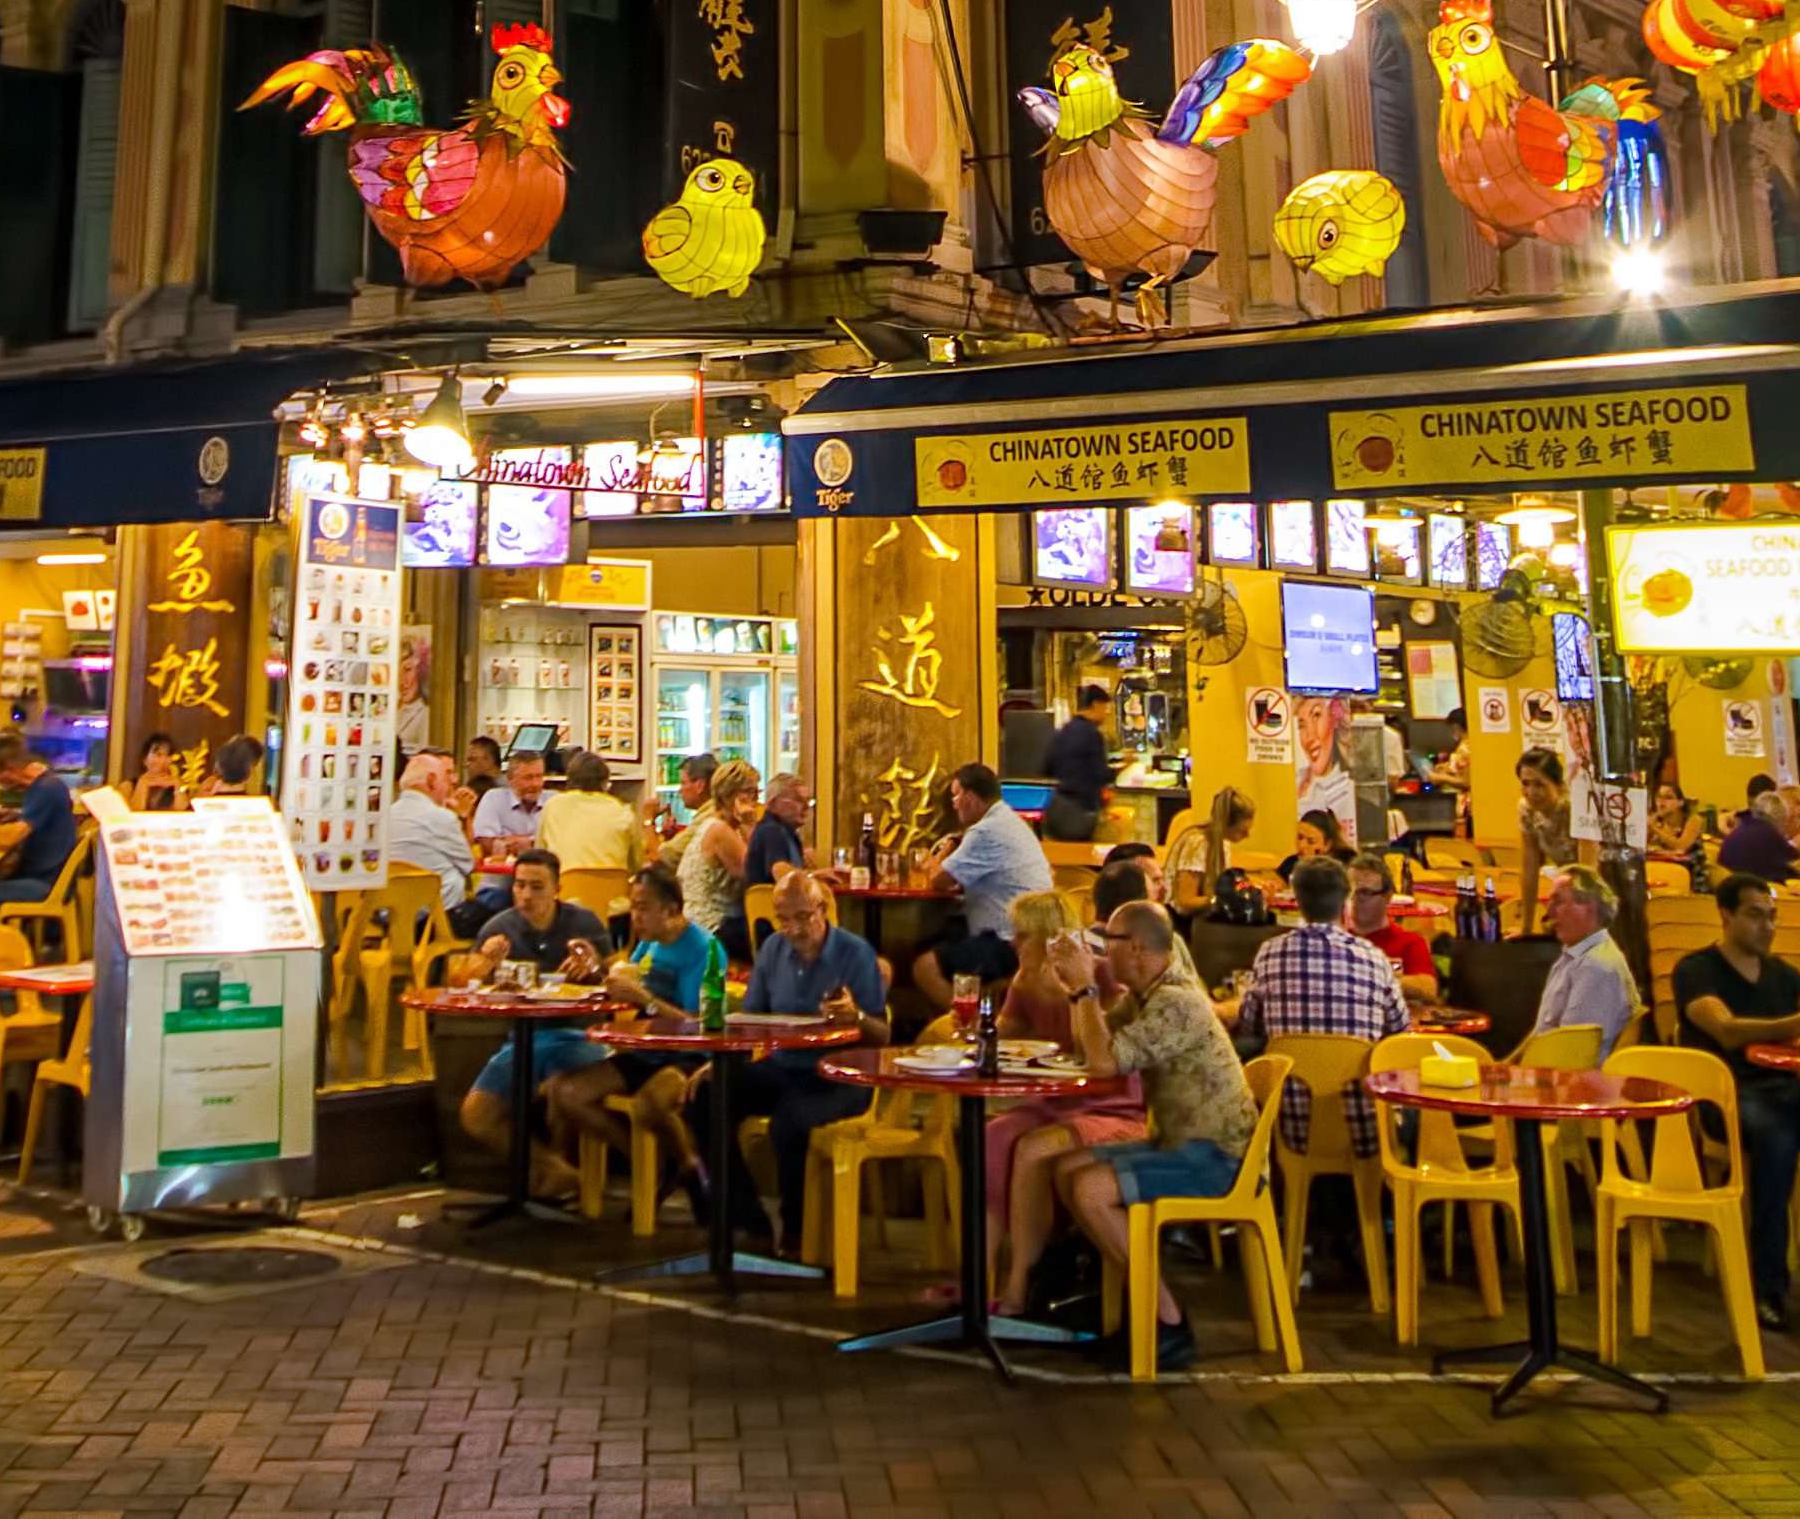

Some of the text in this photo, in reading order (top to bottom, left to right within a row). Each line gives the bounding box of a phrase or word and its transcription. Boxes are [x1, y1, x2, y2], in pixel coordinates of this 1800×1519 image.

[1420, 395, 1731, 438] CHINATOWN SEAFOOD
[989, 426, 1235, 463] CHINATOWN SEAFOOD
[1471, 430, 1674, 471] 八道馆鱼虾蟹
[601, 453, 702, 493] Seafood
[1028, 455, 1189, 492] 八道馆鱼虾蟹
[815, 487, 855, 512] Tiger
[1705, 558, 1792, 578] SEAFOOD
